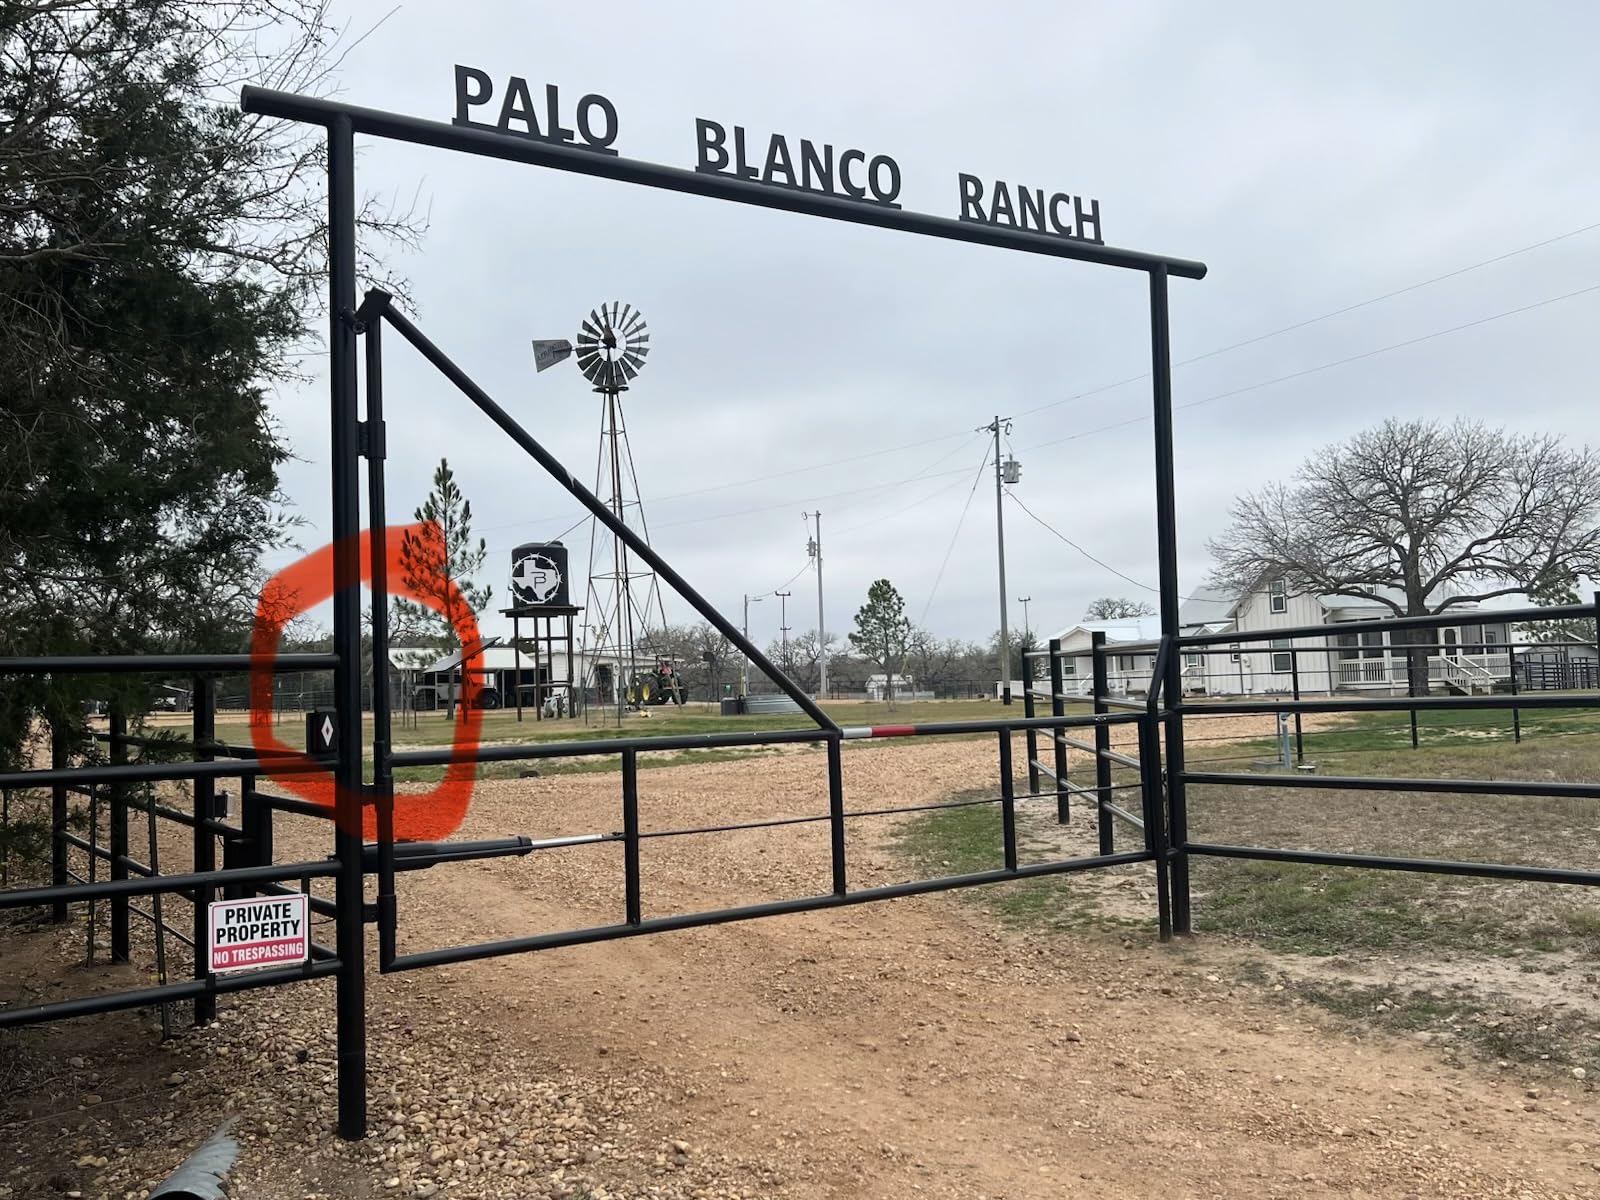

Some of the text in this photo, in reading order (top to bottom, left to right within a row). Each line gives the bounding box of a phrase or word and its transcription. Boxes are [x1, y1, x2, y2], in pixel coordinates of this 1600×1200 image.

[453, 64, 1103, 244] PALO BLANCO RANCH
[225, 903, 292, 925] PRIVATE
[216, 919, 301, 944] PROPERTY
[213, 942, 304, 965] NO TRESPASSING
